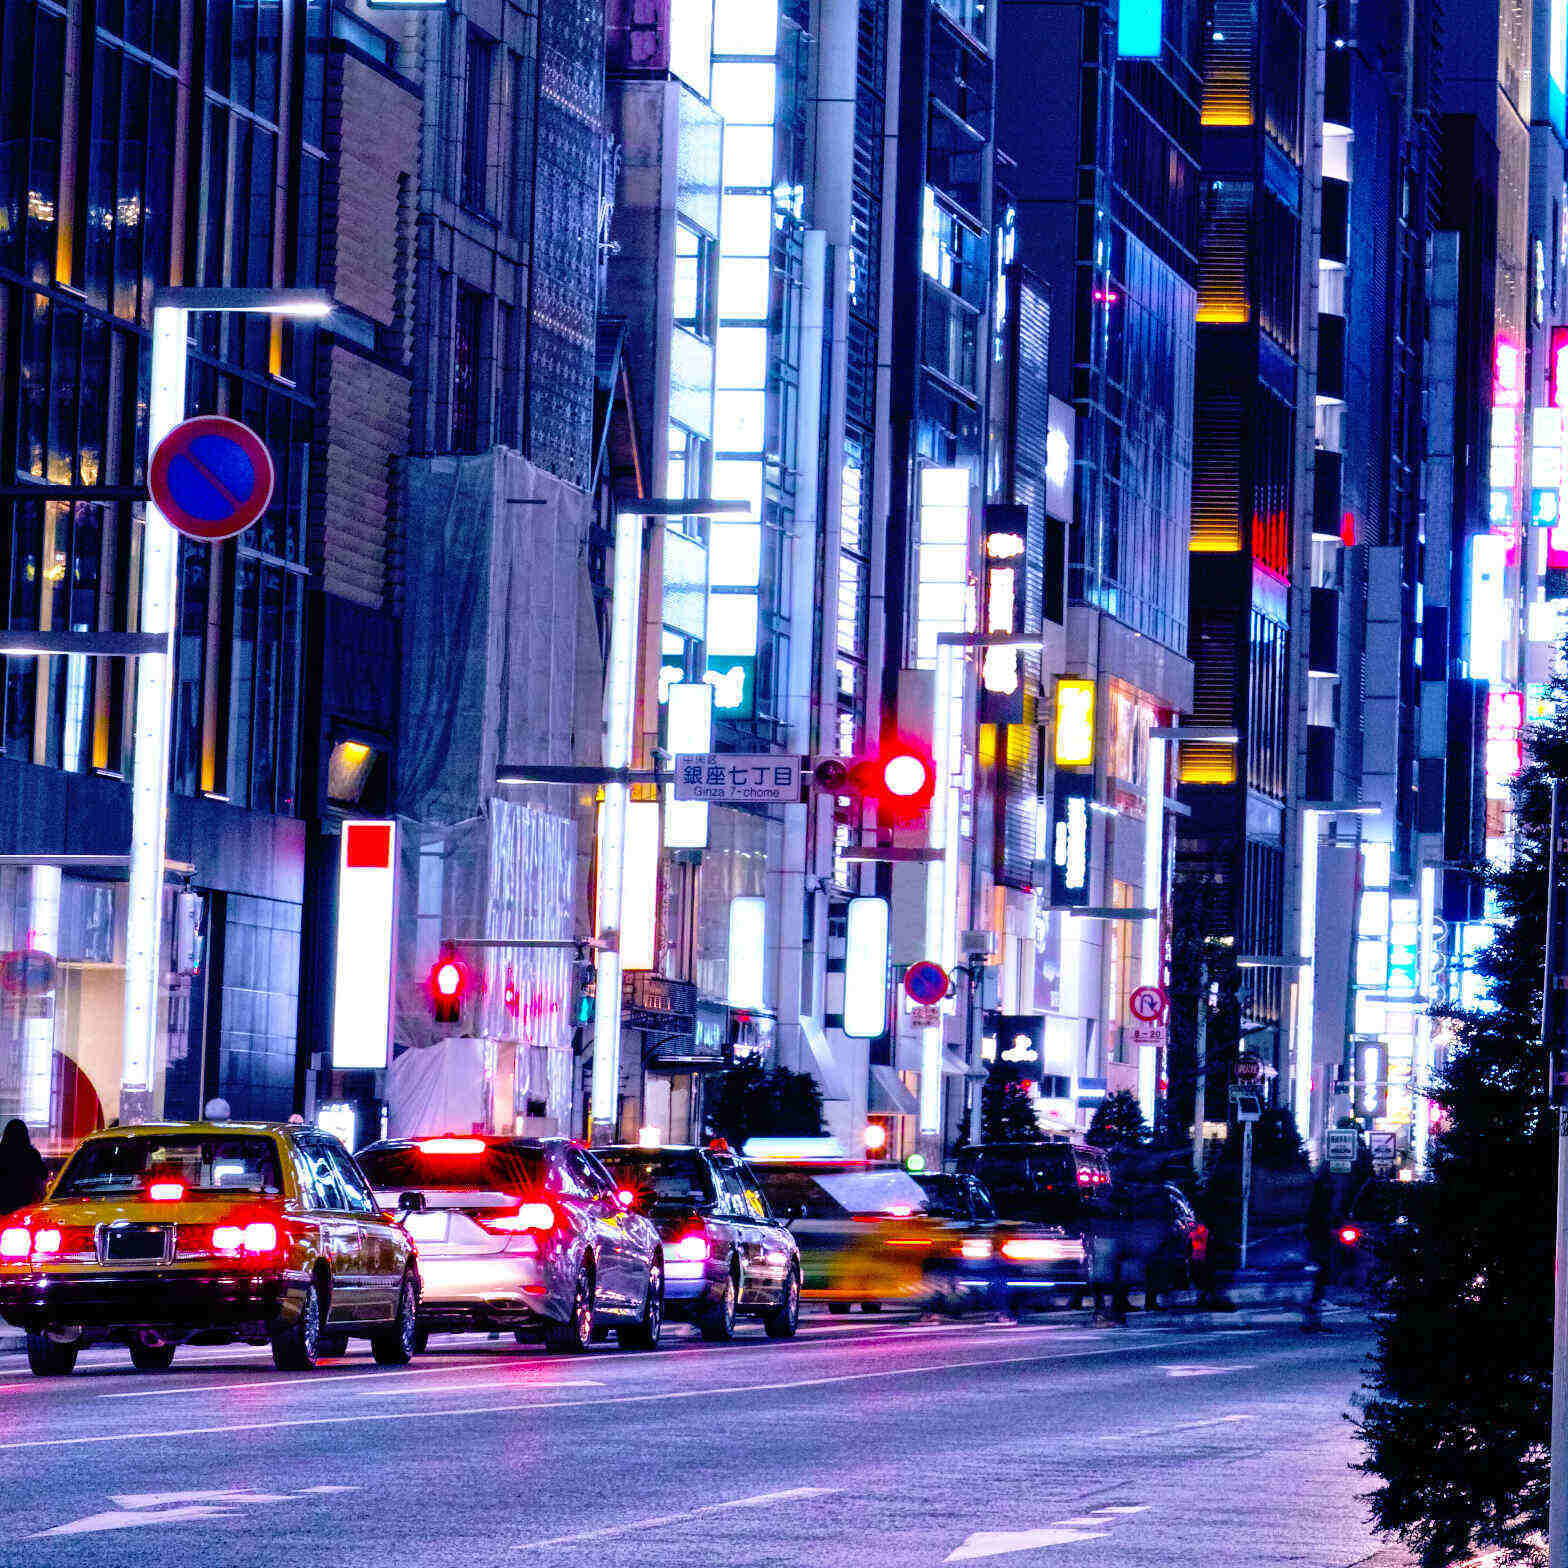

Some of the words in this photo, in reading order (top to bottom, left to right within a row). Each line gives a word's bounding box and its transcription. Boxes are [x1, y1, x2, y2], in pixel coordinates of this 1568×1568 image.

[683, 765, 792, 786] 銀座七丁目
[694, 786, 725, 798] Ginza
[729, 787, 780, 798] 7-chome
